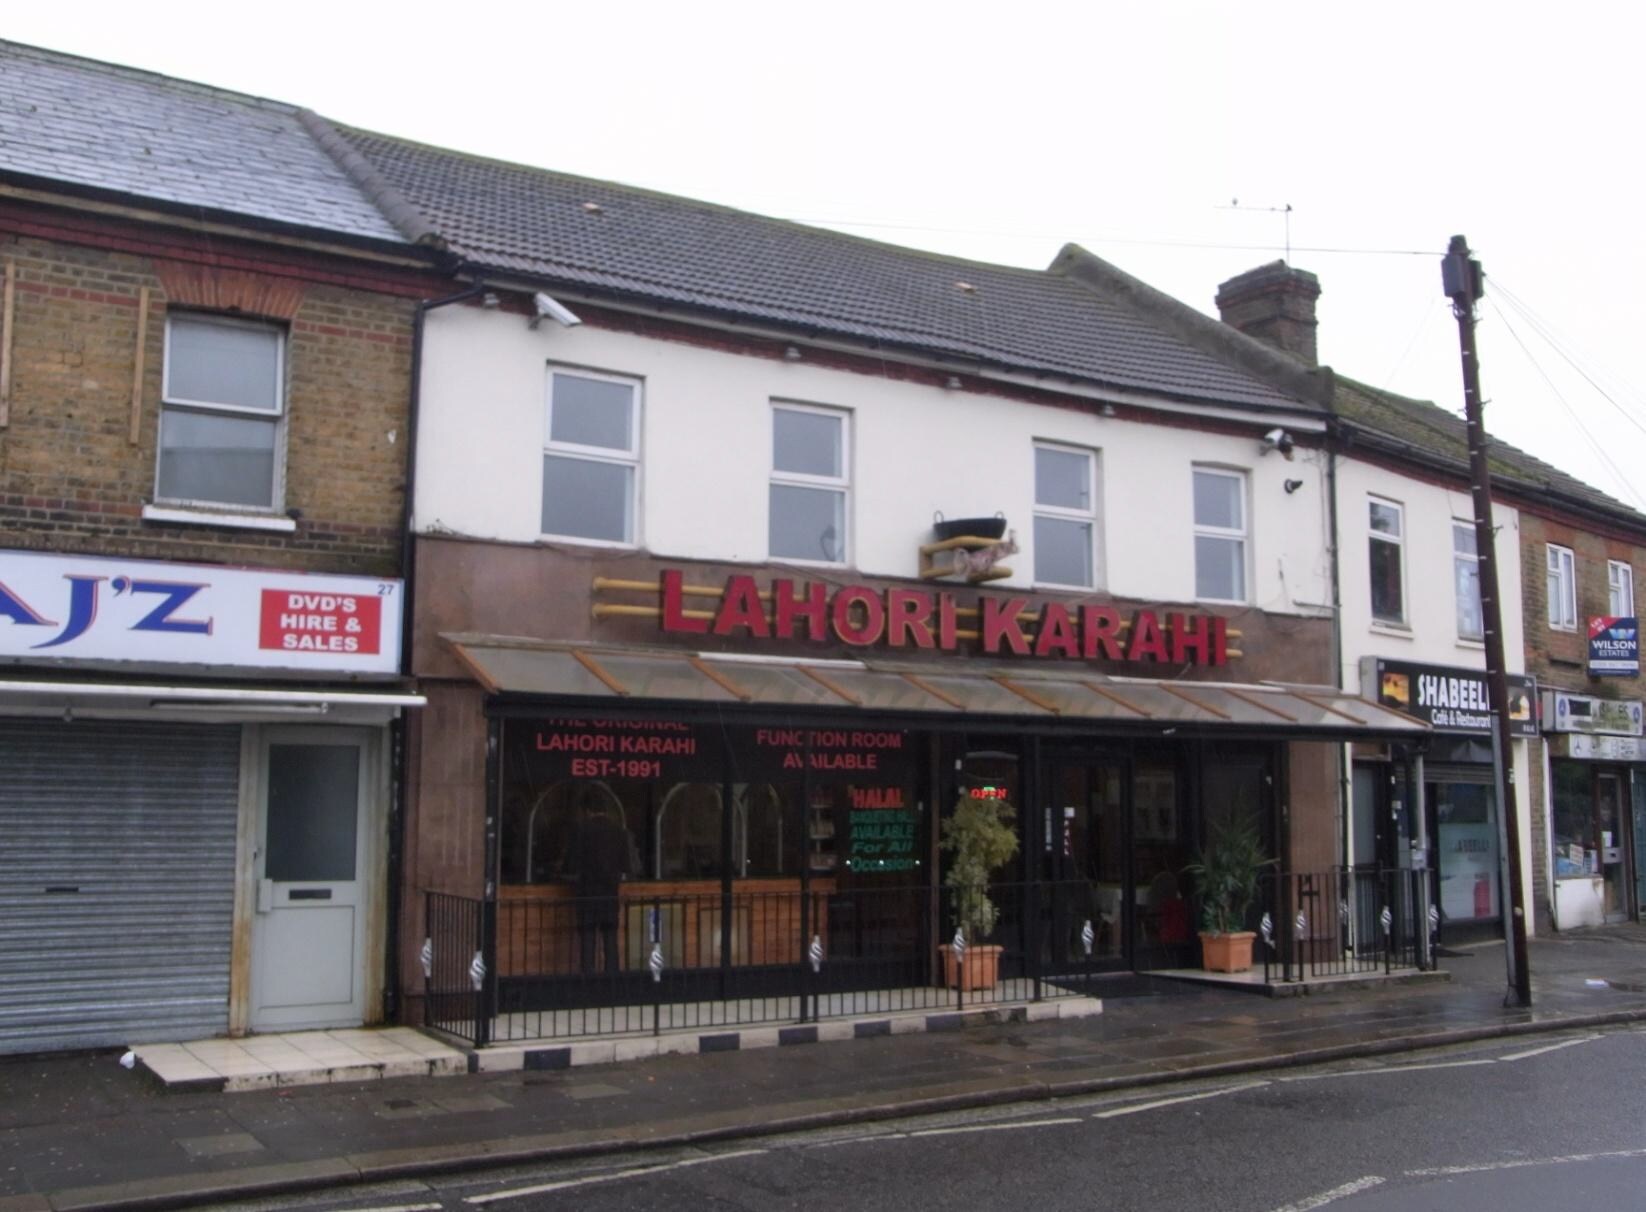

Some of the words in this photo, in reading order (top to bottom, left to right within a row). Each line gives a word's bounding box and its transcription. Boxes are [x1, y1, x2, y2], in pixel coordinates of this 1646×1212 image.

[377, 584, 395, 596] 27
[288, 594, 358, 613] DVD'S
[280, 613, 338, 631] HIRE
[344, 617, 362, 632] &
[659, 569, 957, 651] LAHORI
[981, 597, 1228, 667] KARAHI
[283, 633, 359, 651] SALES
[1592, 640, 1637, 649] WILSON
[1599, 649, 1630, 657] ESTATES
[1418, 673, 1490, 712] SHABEEL
[536, 733, 614, 752] LAHORI
[620, 735, 696, 755] KARAHI
[756, 729, 847, 747] FUNCTION
[852, 732, 902, 748] ROOM
[571, 758, 661, 777] EST-1991
[783, 753, 878, 769] AVAILABLE
[852, 787, 905, 809] HALAL
[851, 841, 884, 854] For
[888, 840, 913, 853] All
